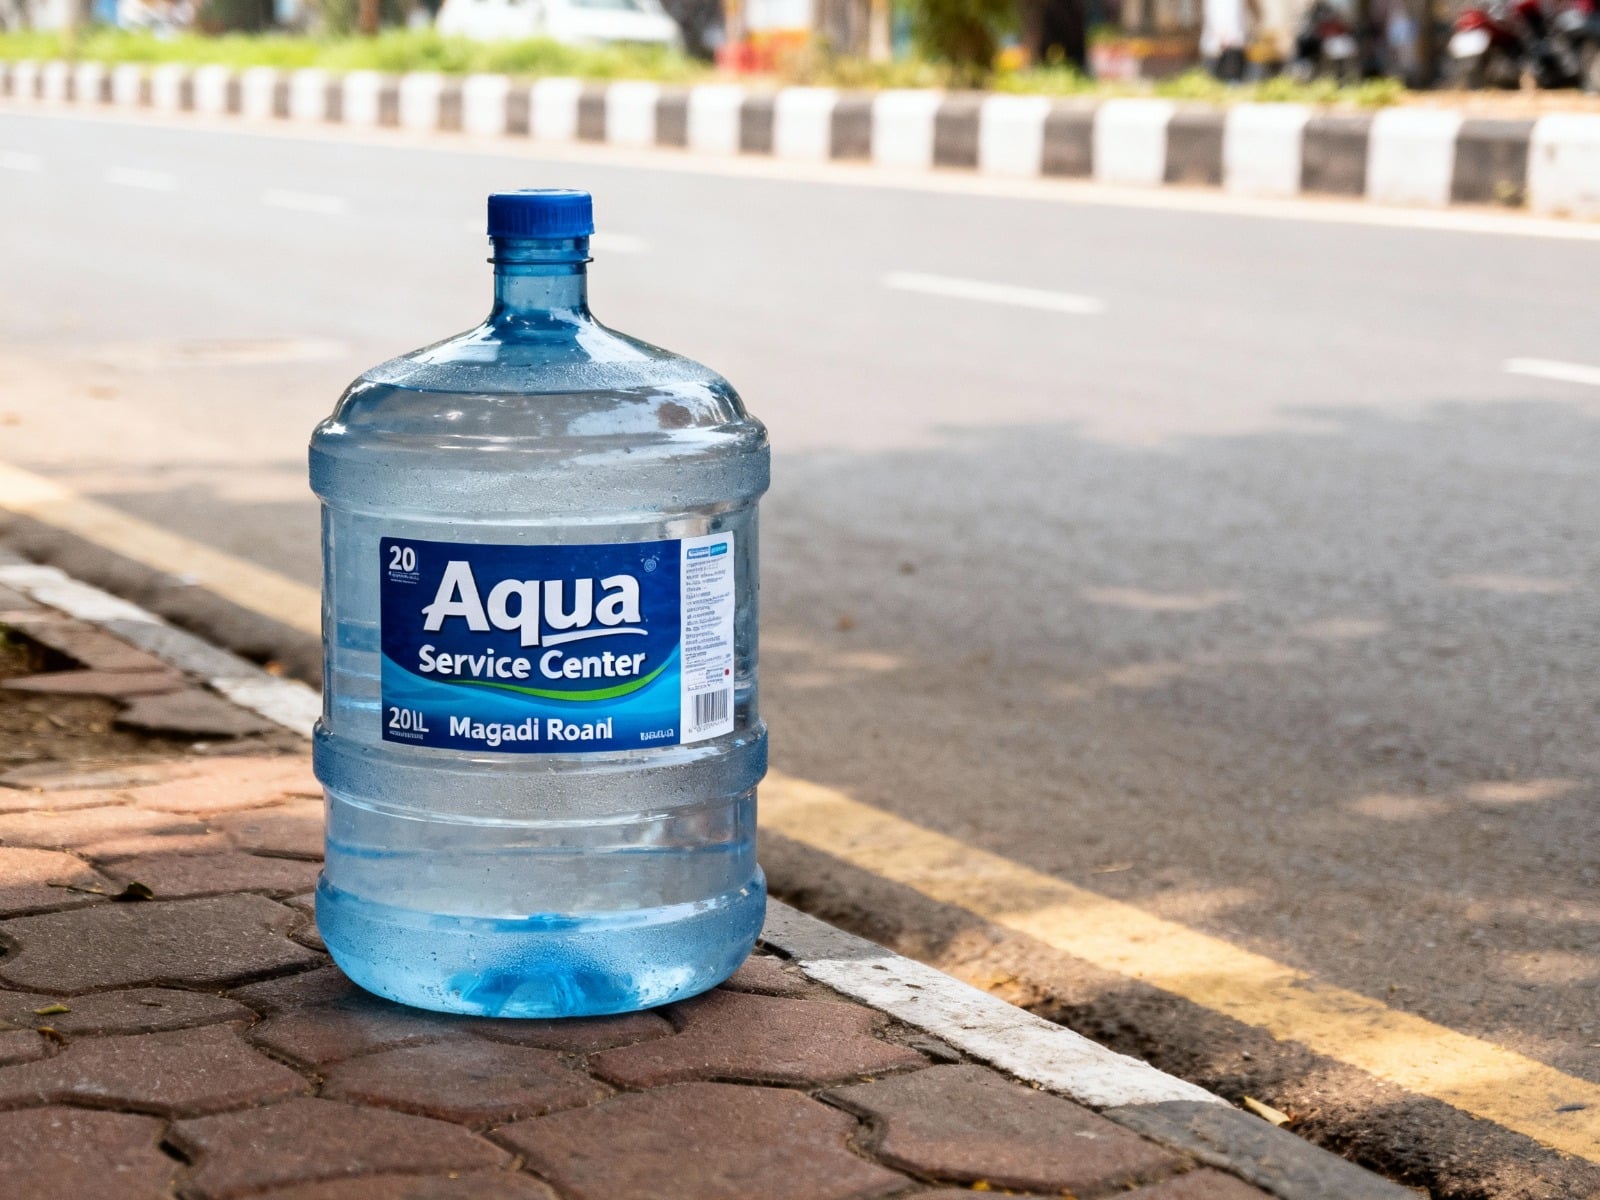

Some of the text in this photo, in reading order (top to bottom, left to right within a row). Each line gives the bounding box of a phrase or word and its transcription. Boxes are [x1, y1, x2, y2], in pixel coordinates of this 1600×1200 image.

[389, 545, 416, 572] 20
[421, 560, 642, 647] Aqua
[418, 643, 532, 680] Service
[539, 649, 647, 680] Center
[449, 715, 539, 747] Magadi
